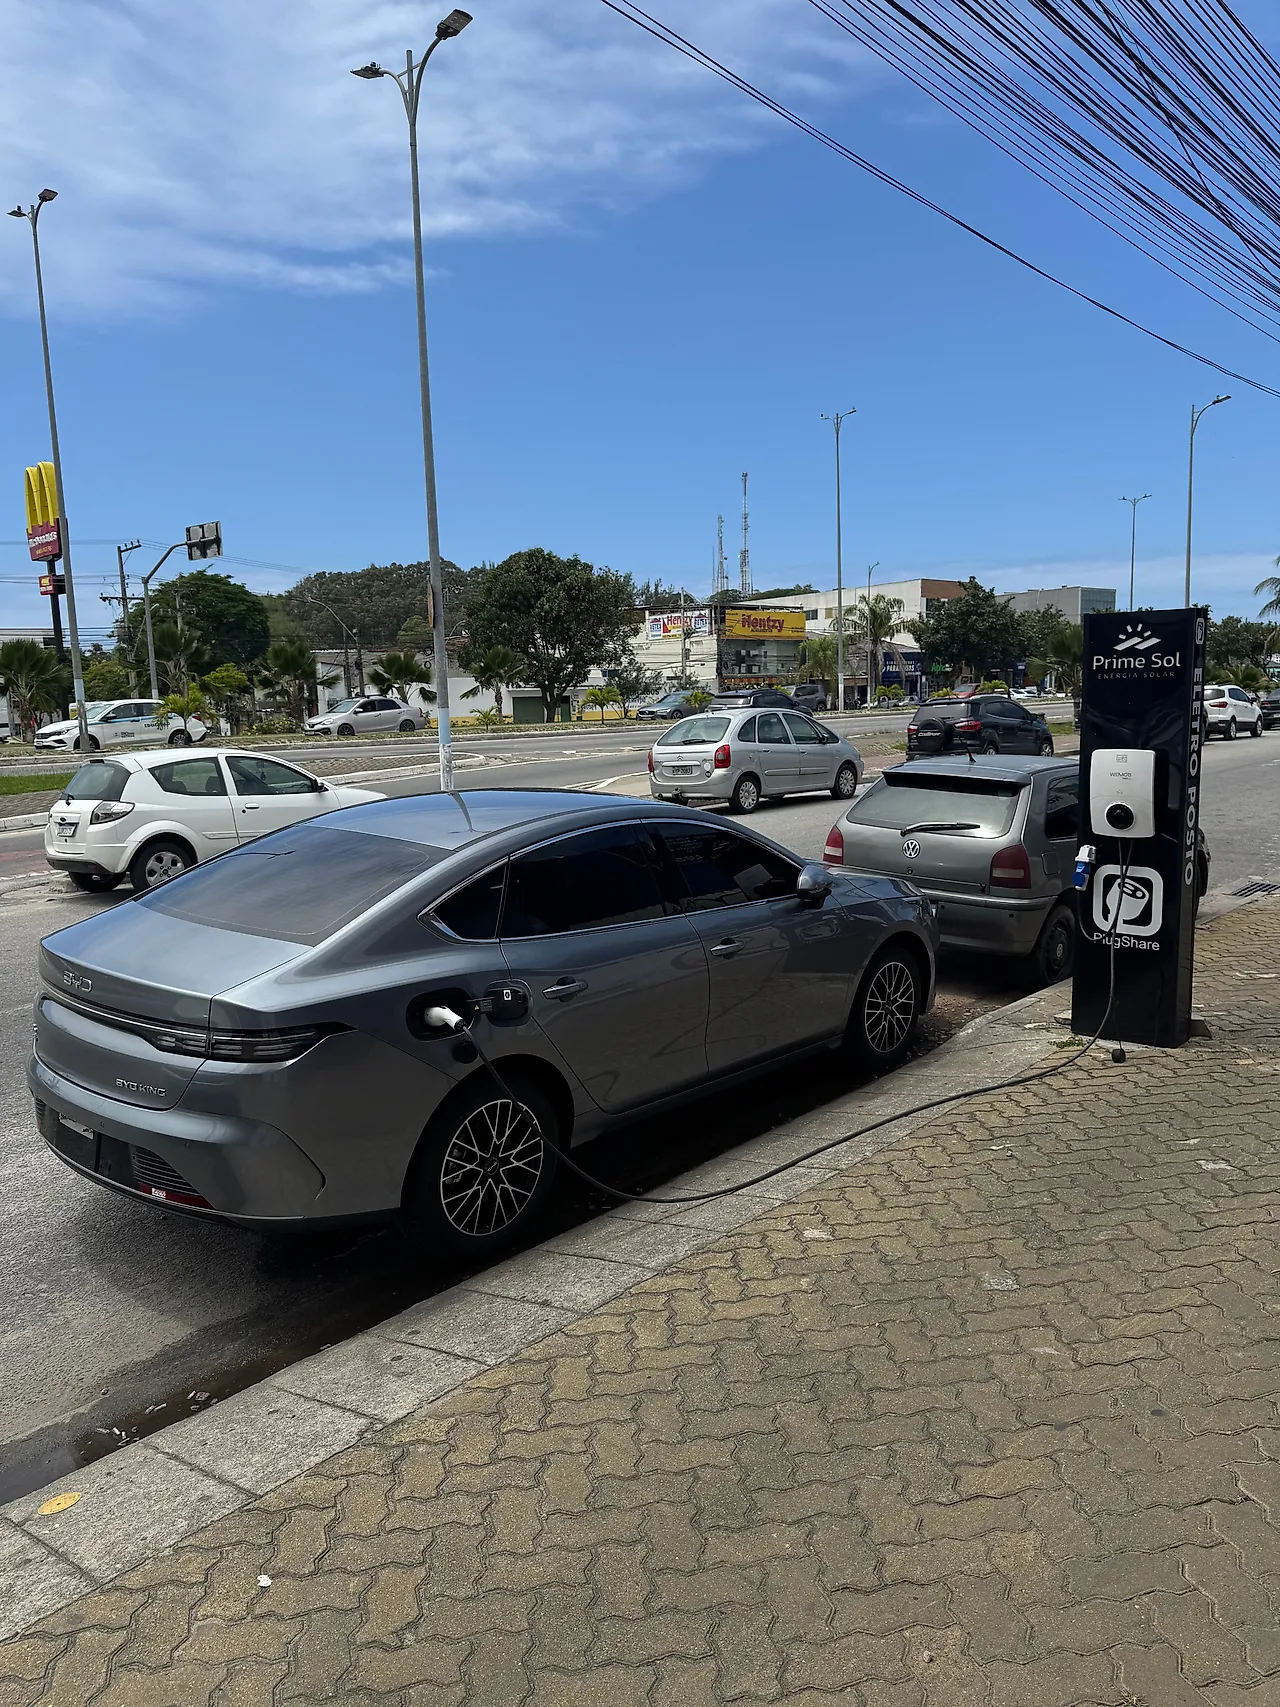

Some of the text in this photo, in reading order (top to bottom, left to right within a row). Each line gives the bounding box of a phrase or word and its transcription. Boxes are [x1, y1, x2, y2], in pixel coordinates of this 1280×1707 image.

[741, 614, 784, 632] Hentzy
[1092, 651, 1181, 670] Prime Sol
[1184, 667, 1203, 886] ELETRO POSTO
[63, 970, 92, 993] BYD
[115, 1078, 167, 1097] BYD KING
